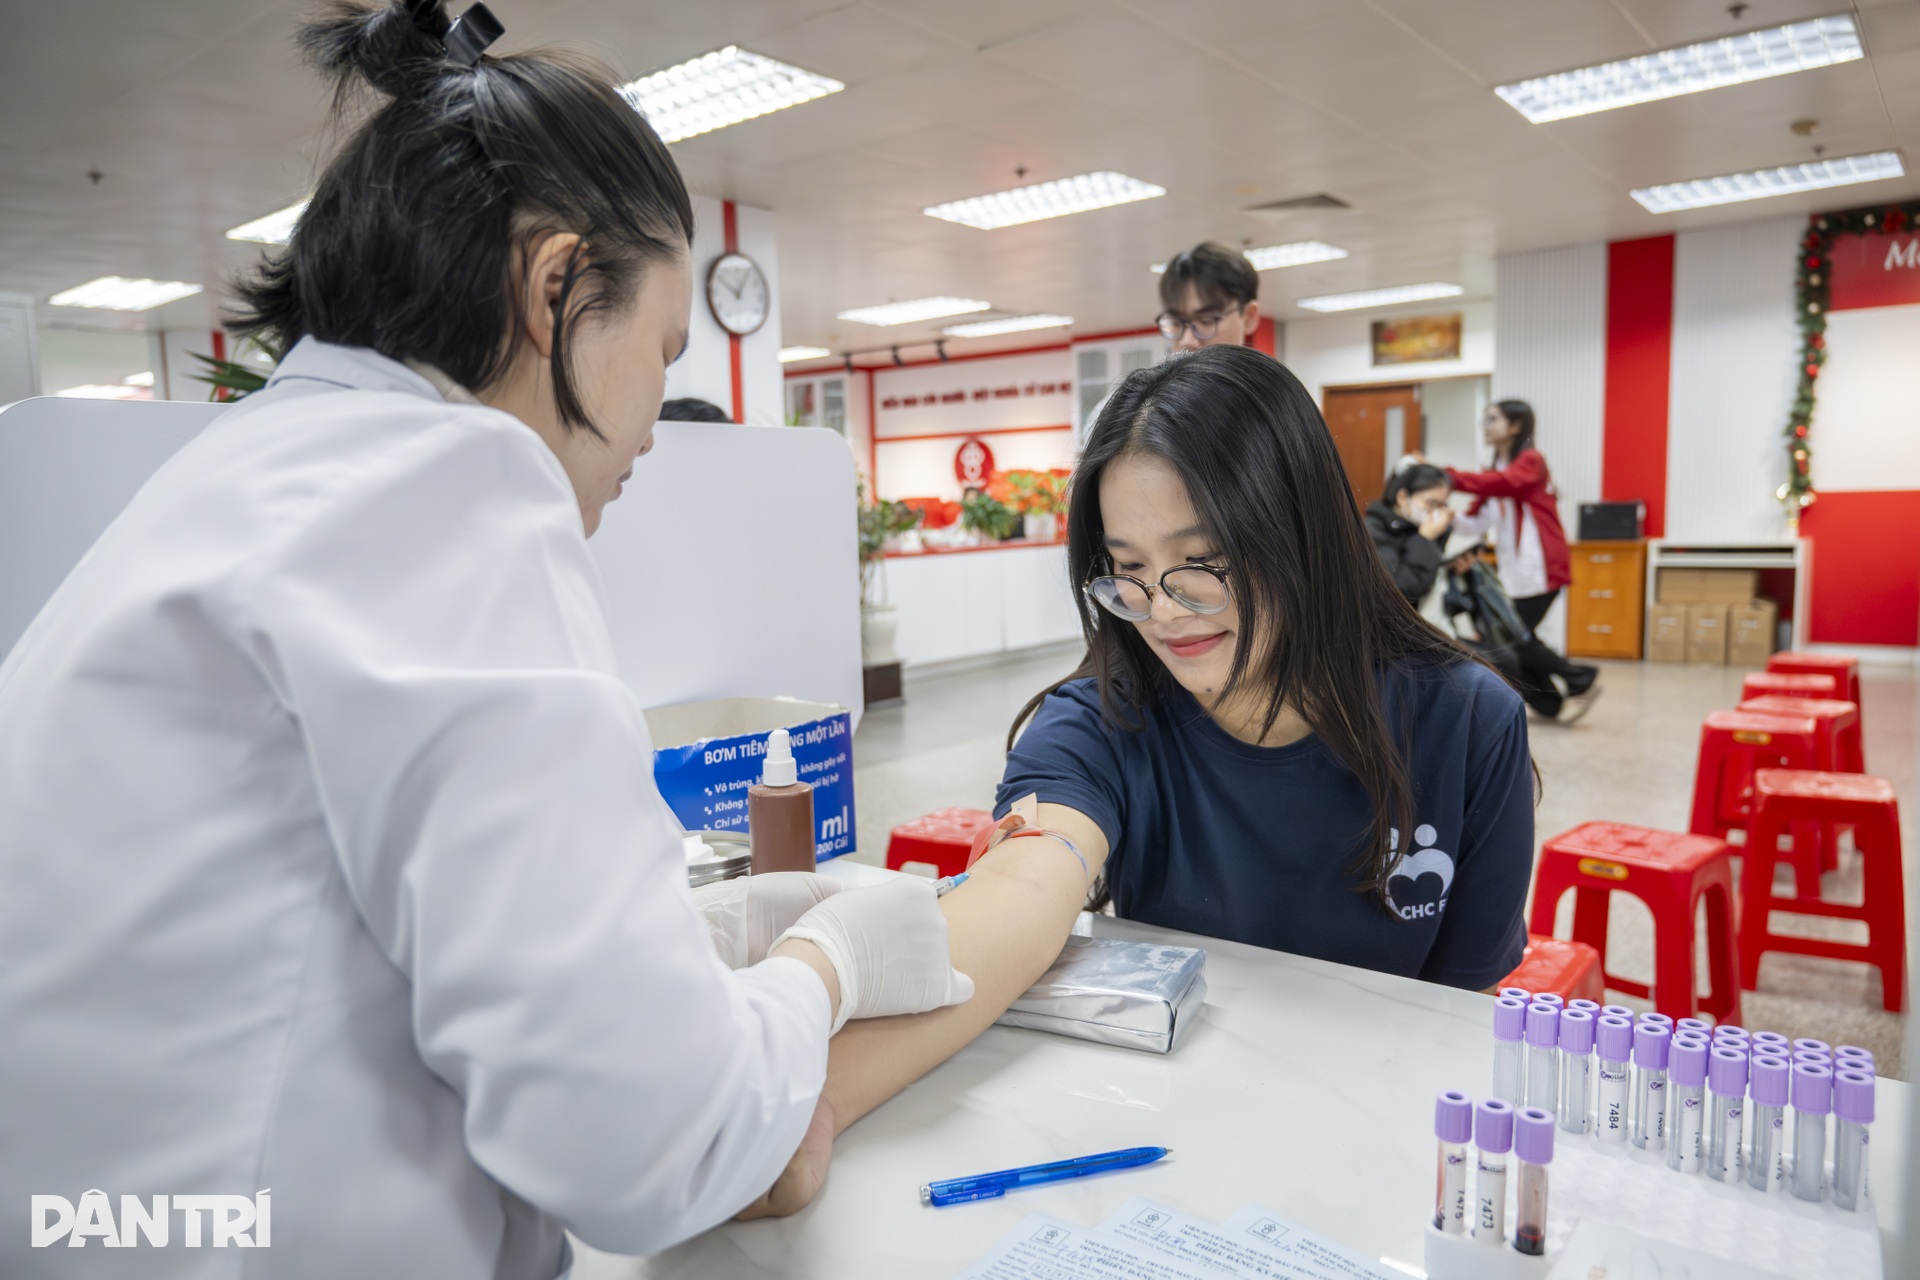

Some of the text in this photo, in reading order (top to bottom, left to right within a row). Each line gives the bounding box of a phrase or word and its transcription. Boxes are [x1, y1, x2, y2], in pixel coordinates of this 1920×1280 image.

[1884, 238, 1920, 272] M
[704, 720, 846, 766] BƠM TIÊM NG MỘT LẦN
[715, 781, 728, 794] Vô
[801, 759, 824, 775] không
[715, 797, 744, 813] Không
[821, 804, 850, 840] ml
[816, 842, 834, 855] 200
[1401, 898, 1447, 920] CHC F
[1609, 1102, 1620, 1130] 7484
[1481, 1198, 1494, 1229] 7473
